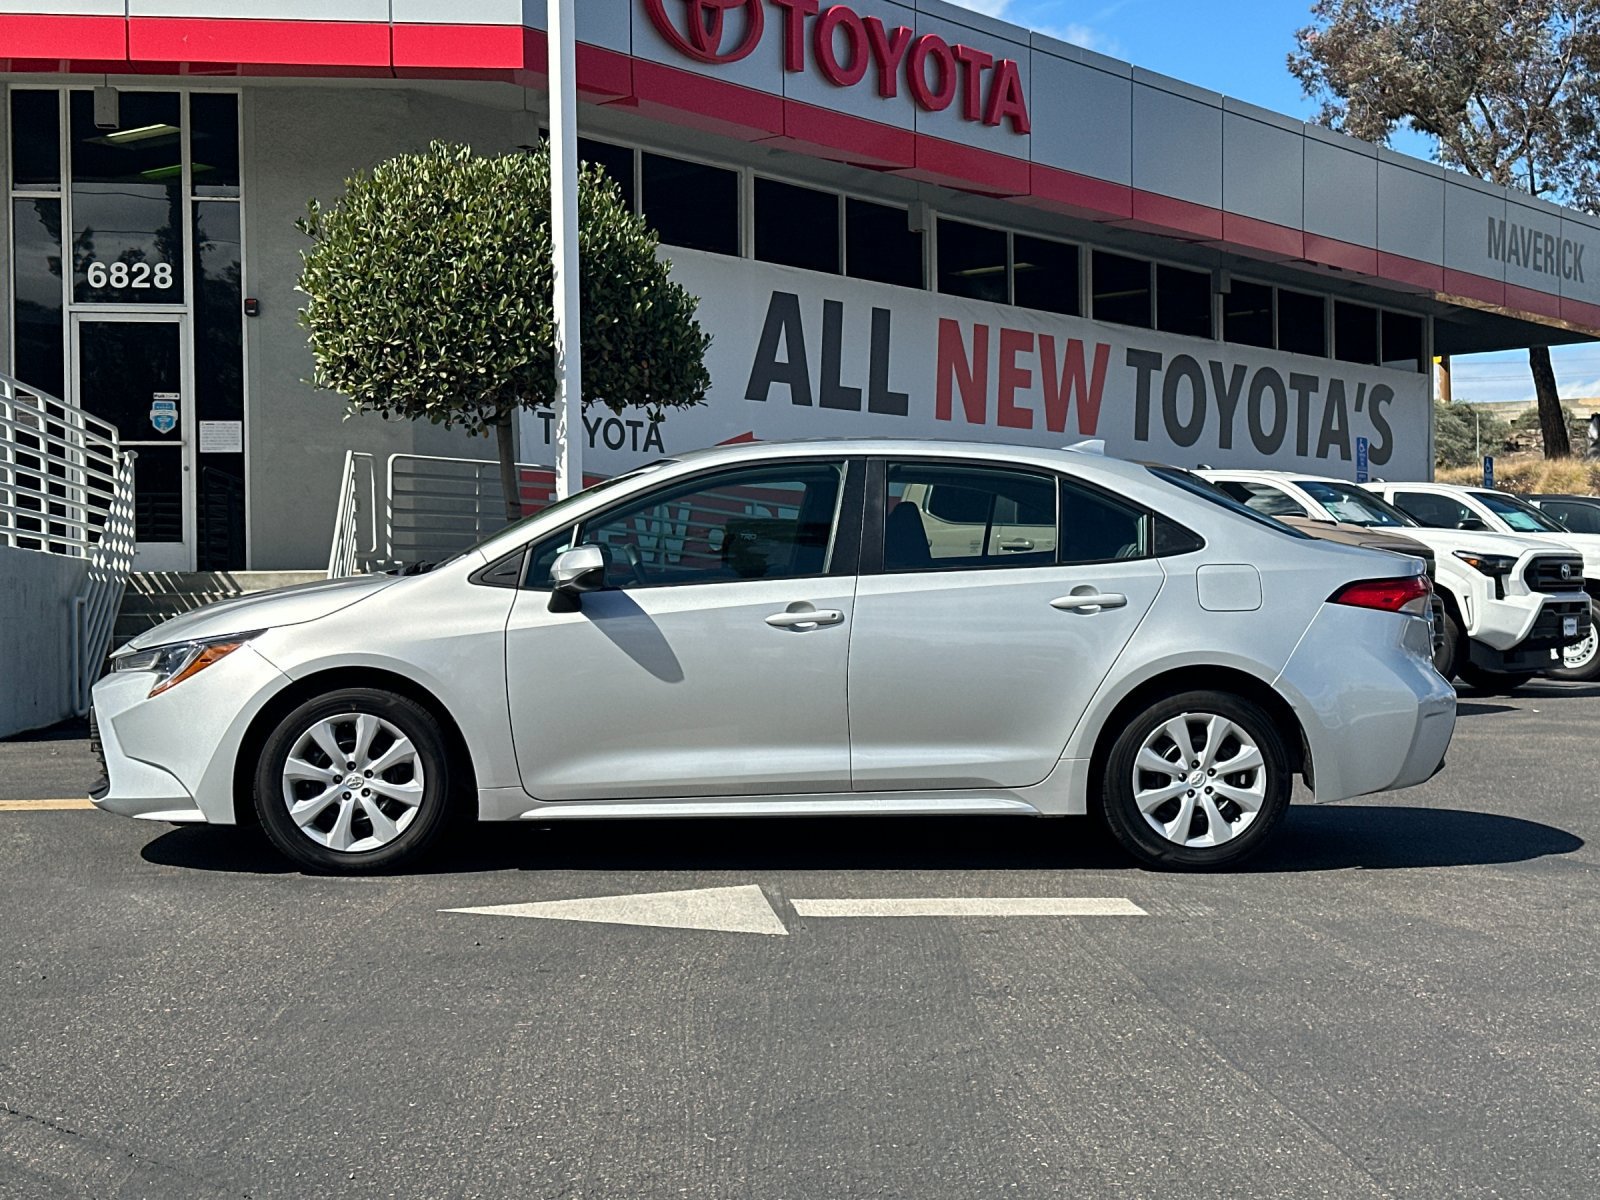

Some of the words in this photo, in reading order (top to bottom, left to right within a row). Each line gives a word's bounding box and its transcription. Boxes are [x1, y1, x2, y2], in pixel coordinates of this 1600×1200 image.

[772, 0, 1031, 135] TOYOTA
[87, 261, 173, 289] 6828
[1487, 215, 1585, 284] MAVERICK
[744, 290, 909, 417] ALL
[935, 317, 1112, 436] NEW
[1126, 347, 1395, 466] TOYOTA'S
[537, 411, 665, 454] TYOTA
